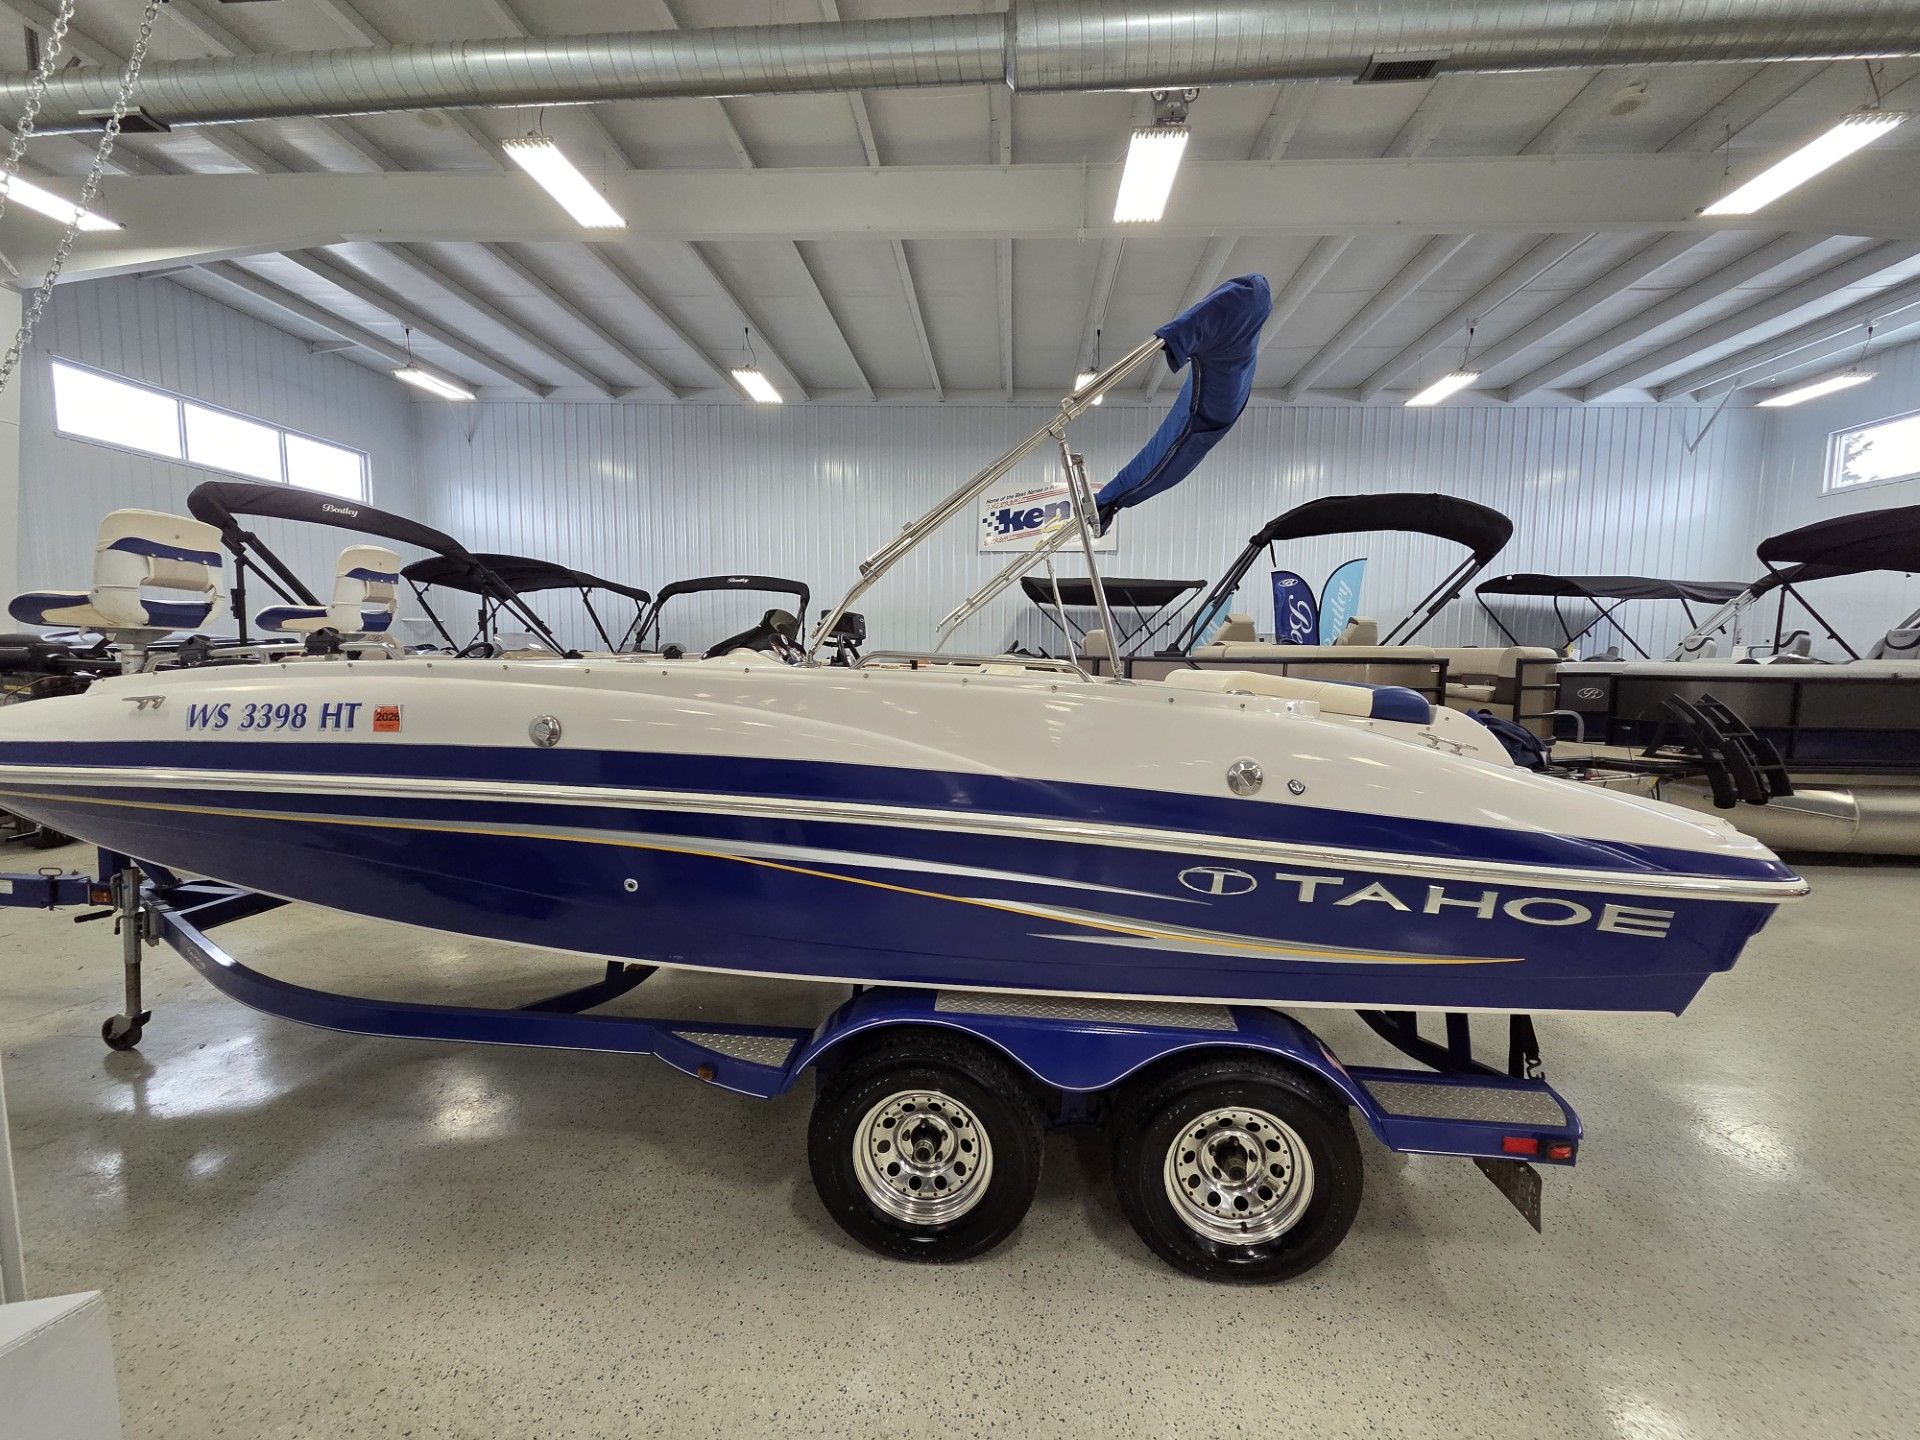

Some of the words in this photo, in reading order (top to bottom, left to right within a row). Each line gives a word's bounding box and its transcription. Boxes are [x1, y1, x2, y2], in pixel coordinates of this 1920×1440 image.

[322, 503, 359, 518] Bentley
[997, 500, 1071, 535] ken
[187, 703, 232, 729] WS
[239, 703, 308, 729] 3398
[319, 702, 364, 729] HT
[1274, 872, 1676, 938] TAHOE
